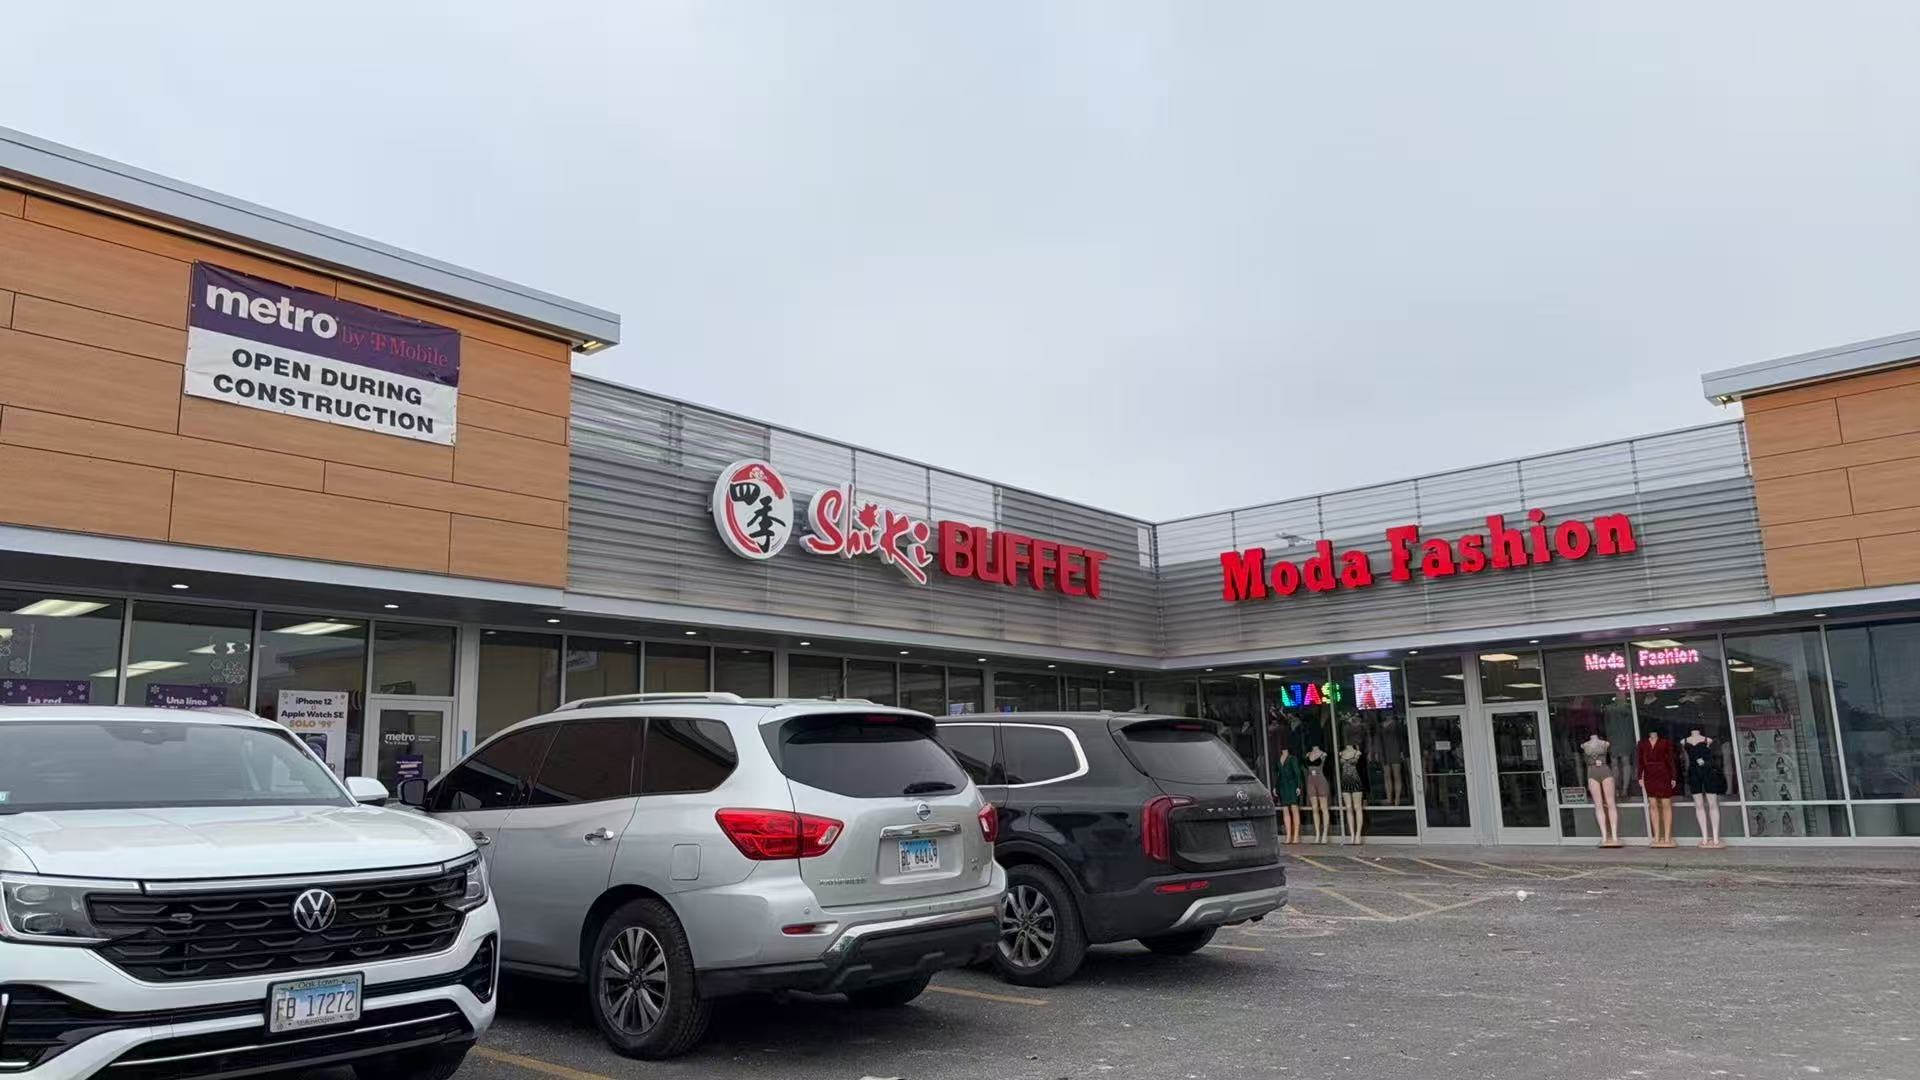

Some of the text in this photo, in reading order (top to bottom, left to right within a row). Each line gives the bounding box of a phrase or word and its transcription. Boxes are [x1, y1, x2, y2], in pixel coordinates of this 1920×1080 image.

[206, 284, 338, 339] metro
[213, 374, 434, 434] CONSTRUCTION
[231, 348, 422, 406] OPEN DURING
[730, 482, 786, 553] 四季
[938, 520, 1109, 600] BUFFET
[1220, 508, 1638, 602] Moda Fashion
[1638, 647, 1699, 667] Fashion
[281, 710, 306, 719] Apple
[306, 711, 333, 719] Watch
[295, 697, 323, 705] iPhone
[385, 733, 415, 742] metro
[276, 990, 354, 1020] FB 17272
